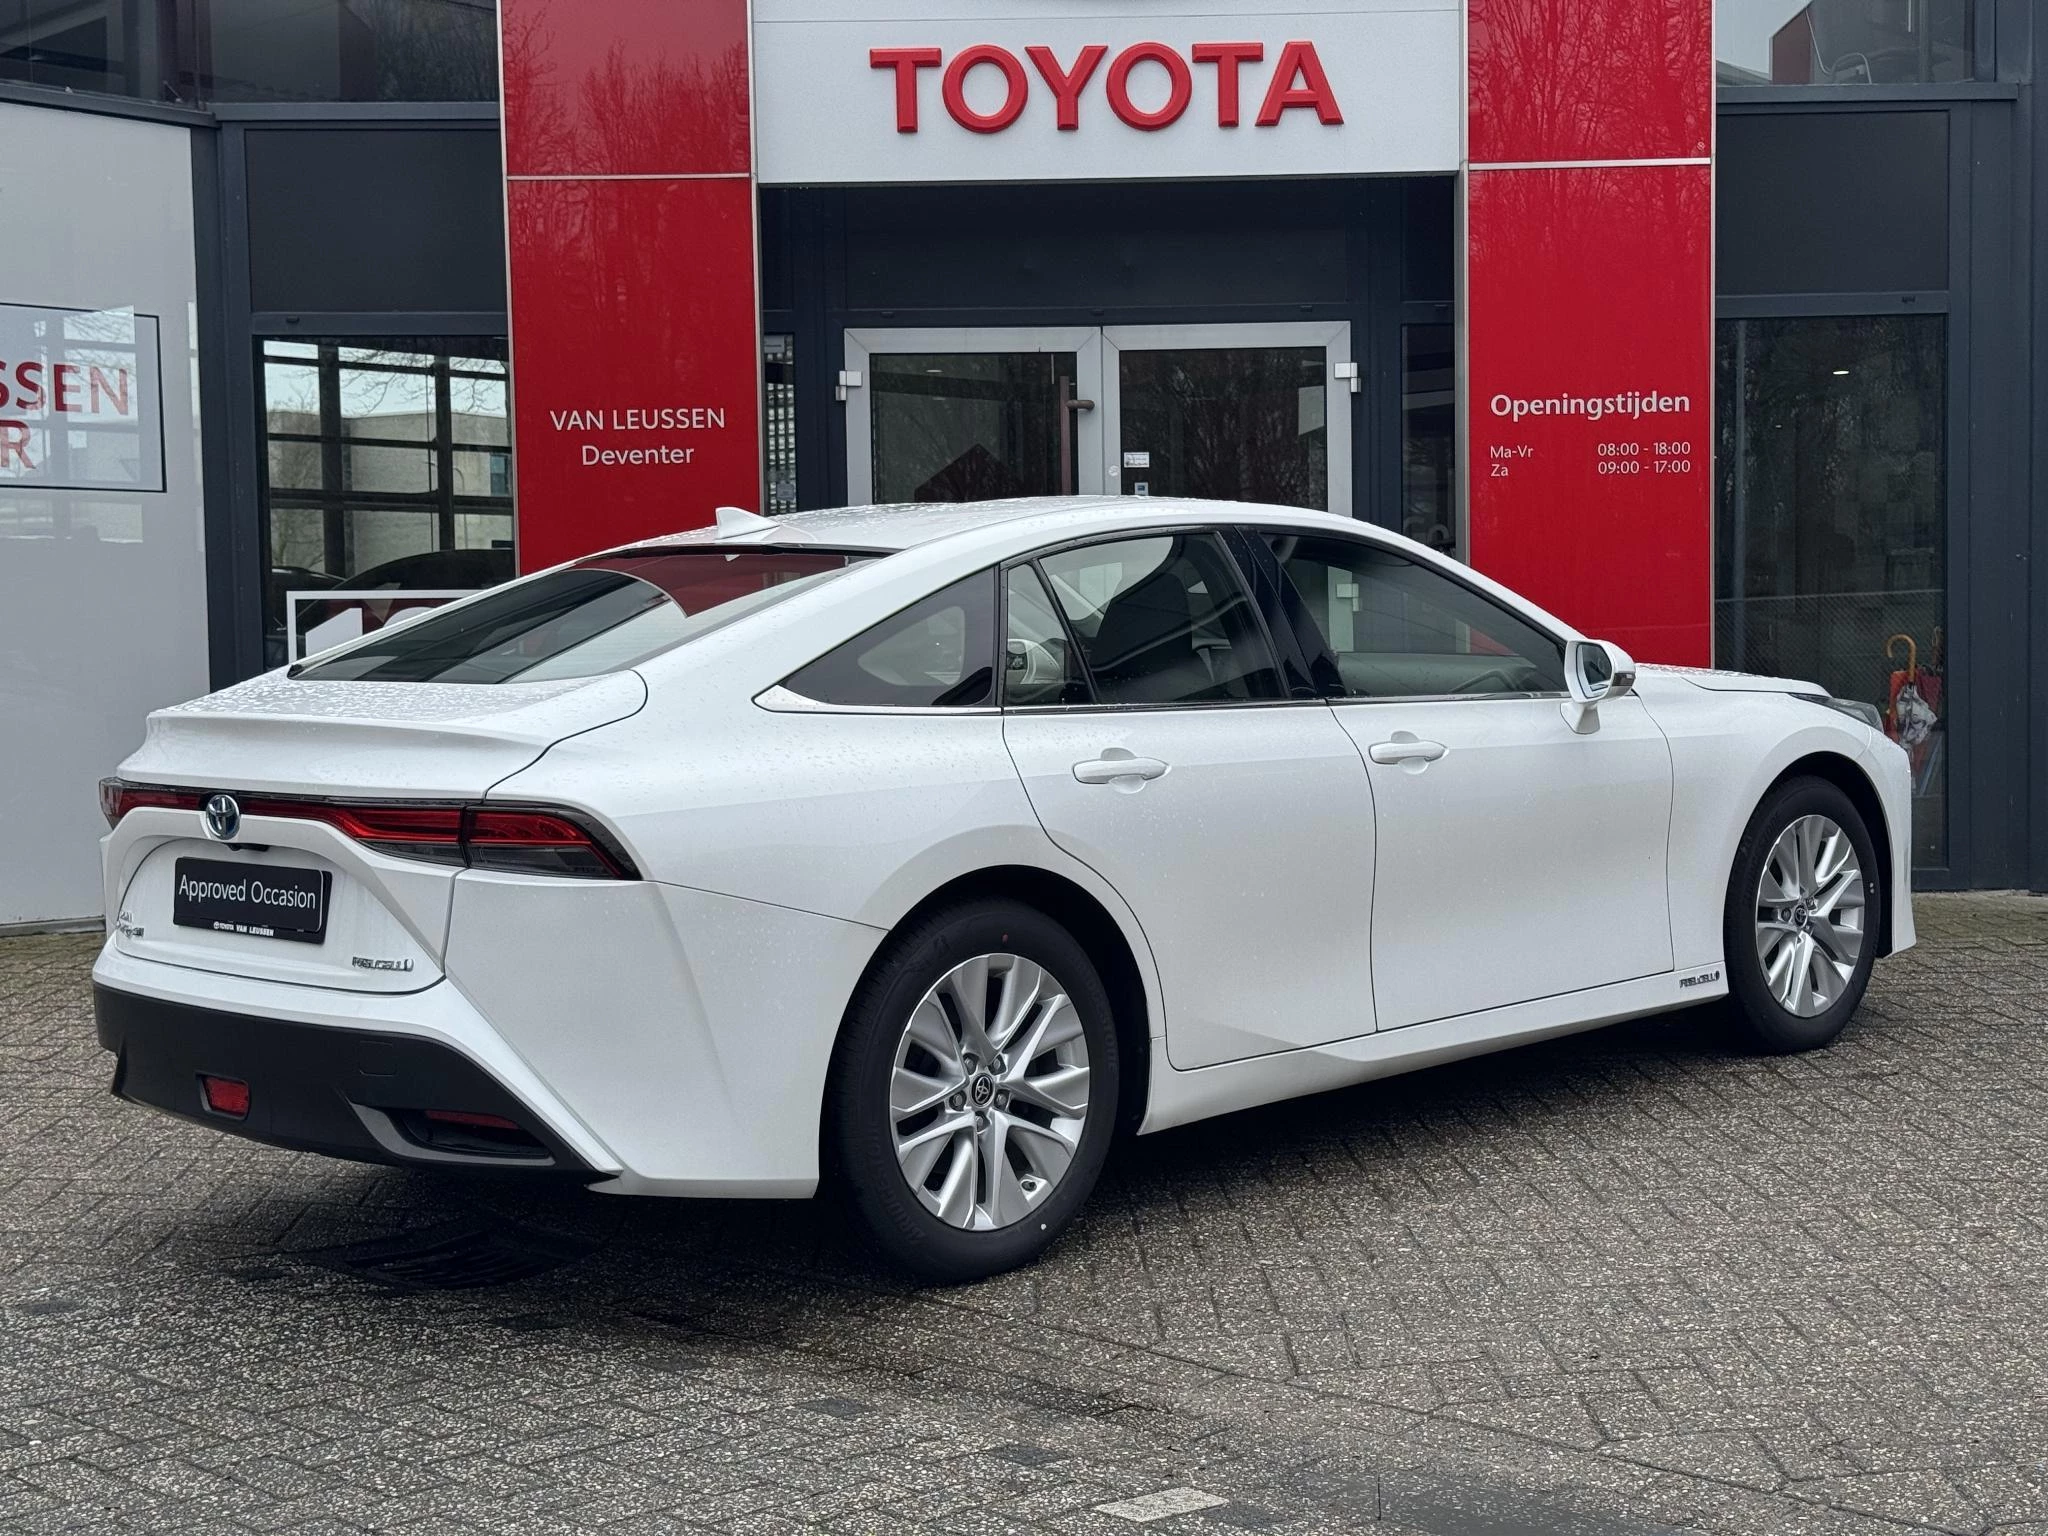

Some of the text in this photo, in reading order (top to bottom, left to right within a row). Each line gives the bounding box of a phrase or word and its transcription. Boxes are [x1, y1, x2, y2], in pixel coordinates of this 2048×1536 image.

[869, 40, 1345, 134] TOYOTA
[1490, 390, 1691, 423] Openingstijden
[550, 407, 726, 431] VAN LEUSSEN
[582, 444, 695, 466] Deventer
[1490, 444, 1534, 459] Ma-Vr
[1597, 442, 1639, 456] 08:00
[1653, 441, 1691, 456] 18:00
[1490, 463, 1509, 477] Za
[1597, 461, 1639, 475] 09:00
[1653, 459, 1691, 474] 17:00
[178, 873, 317, 910] Approved Occasion
[236, 924, 248, 933] VAN
[249, 926, 275, 937] LEUSSEN
